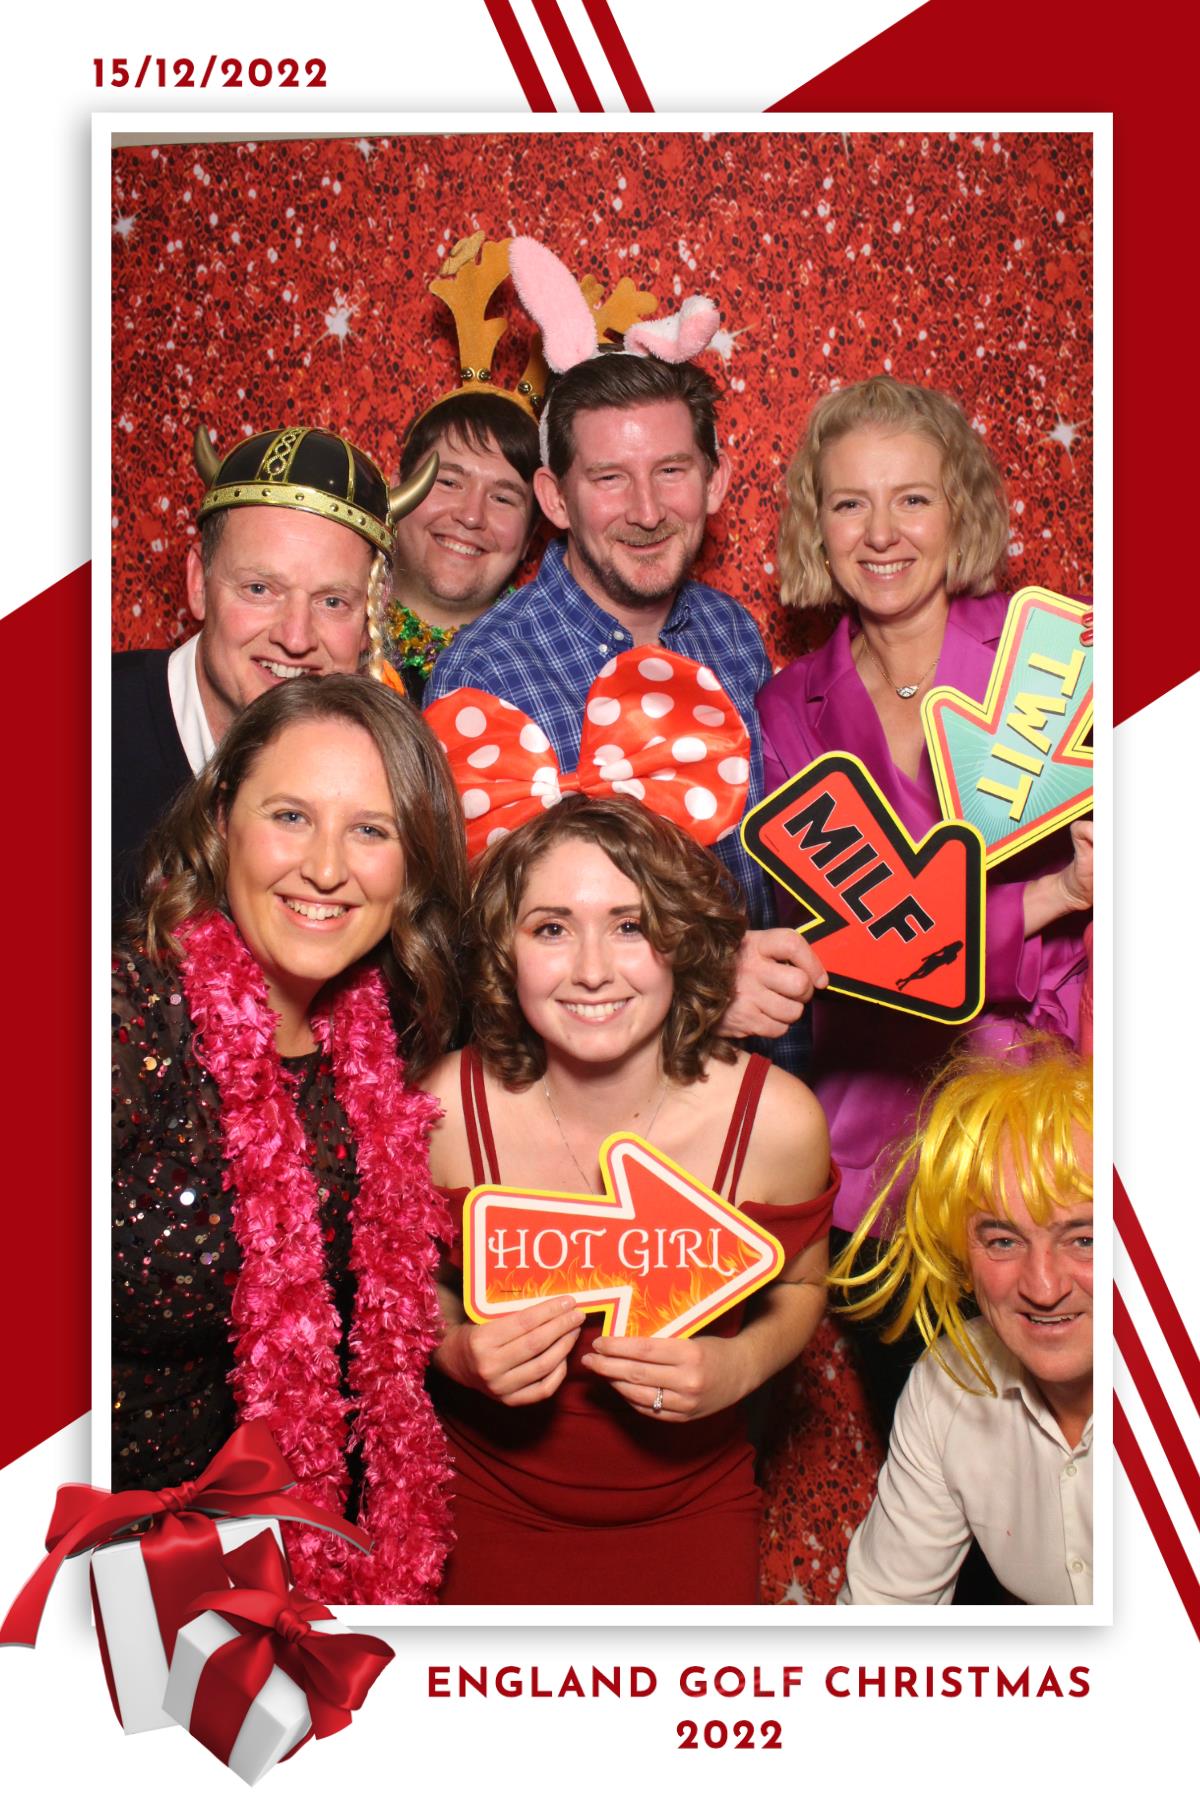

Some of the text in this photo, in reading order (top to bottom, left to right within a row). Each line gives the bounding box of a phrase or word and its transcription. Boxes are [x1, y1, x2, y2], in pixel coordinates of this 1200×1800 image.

[976, 650, 1086, 822] TWIT
[784, 791, 935, 943] MILF
[488, 1228, 737, 1277] HOT GIRL
